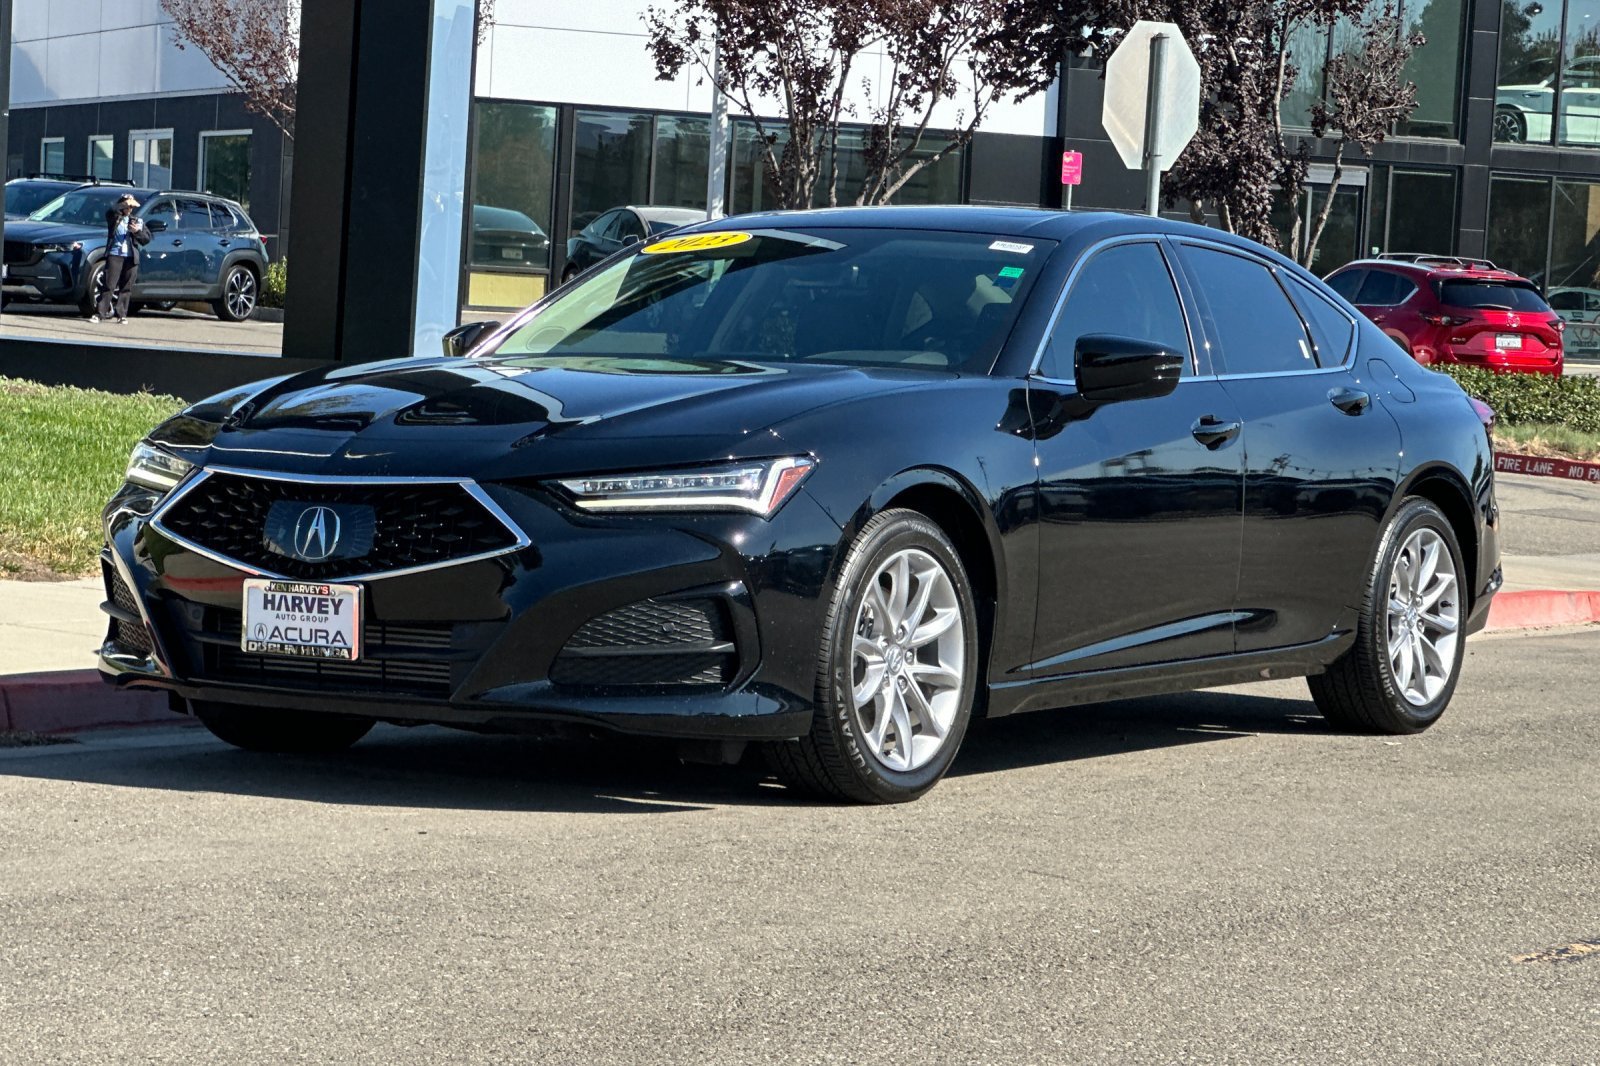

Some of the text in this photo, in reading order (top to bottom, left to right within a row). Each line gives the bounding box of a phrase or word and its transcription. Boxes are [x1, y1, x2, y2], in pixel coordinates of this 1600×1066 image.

[655, 233, 740, 251] 2023
[1497, 456, 1522, 471] FIRE
[1525, 460, 1555, 475] LANE
[1568, 465, 1584, 478] NO
[270, 582, 329, 595] KEN HARVEY'S
[263, 593, 344, 615] HARVEY
[275, 613, 329, 623] AUTO GROUP
[268, 625, 348, 645] ACURA
[247, 641, 350, 659] DUBLIN HONDA
